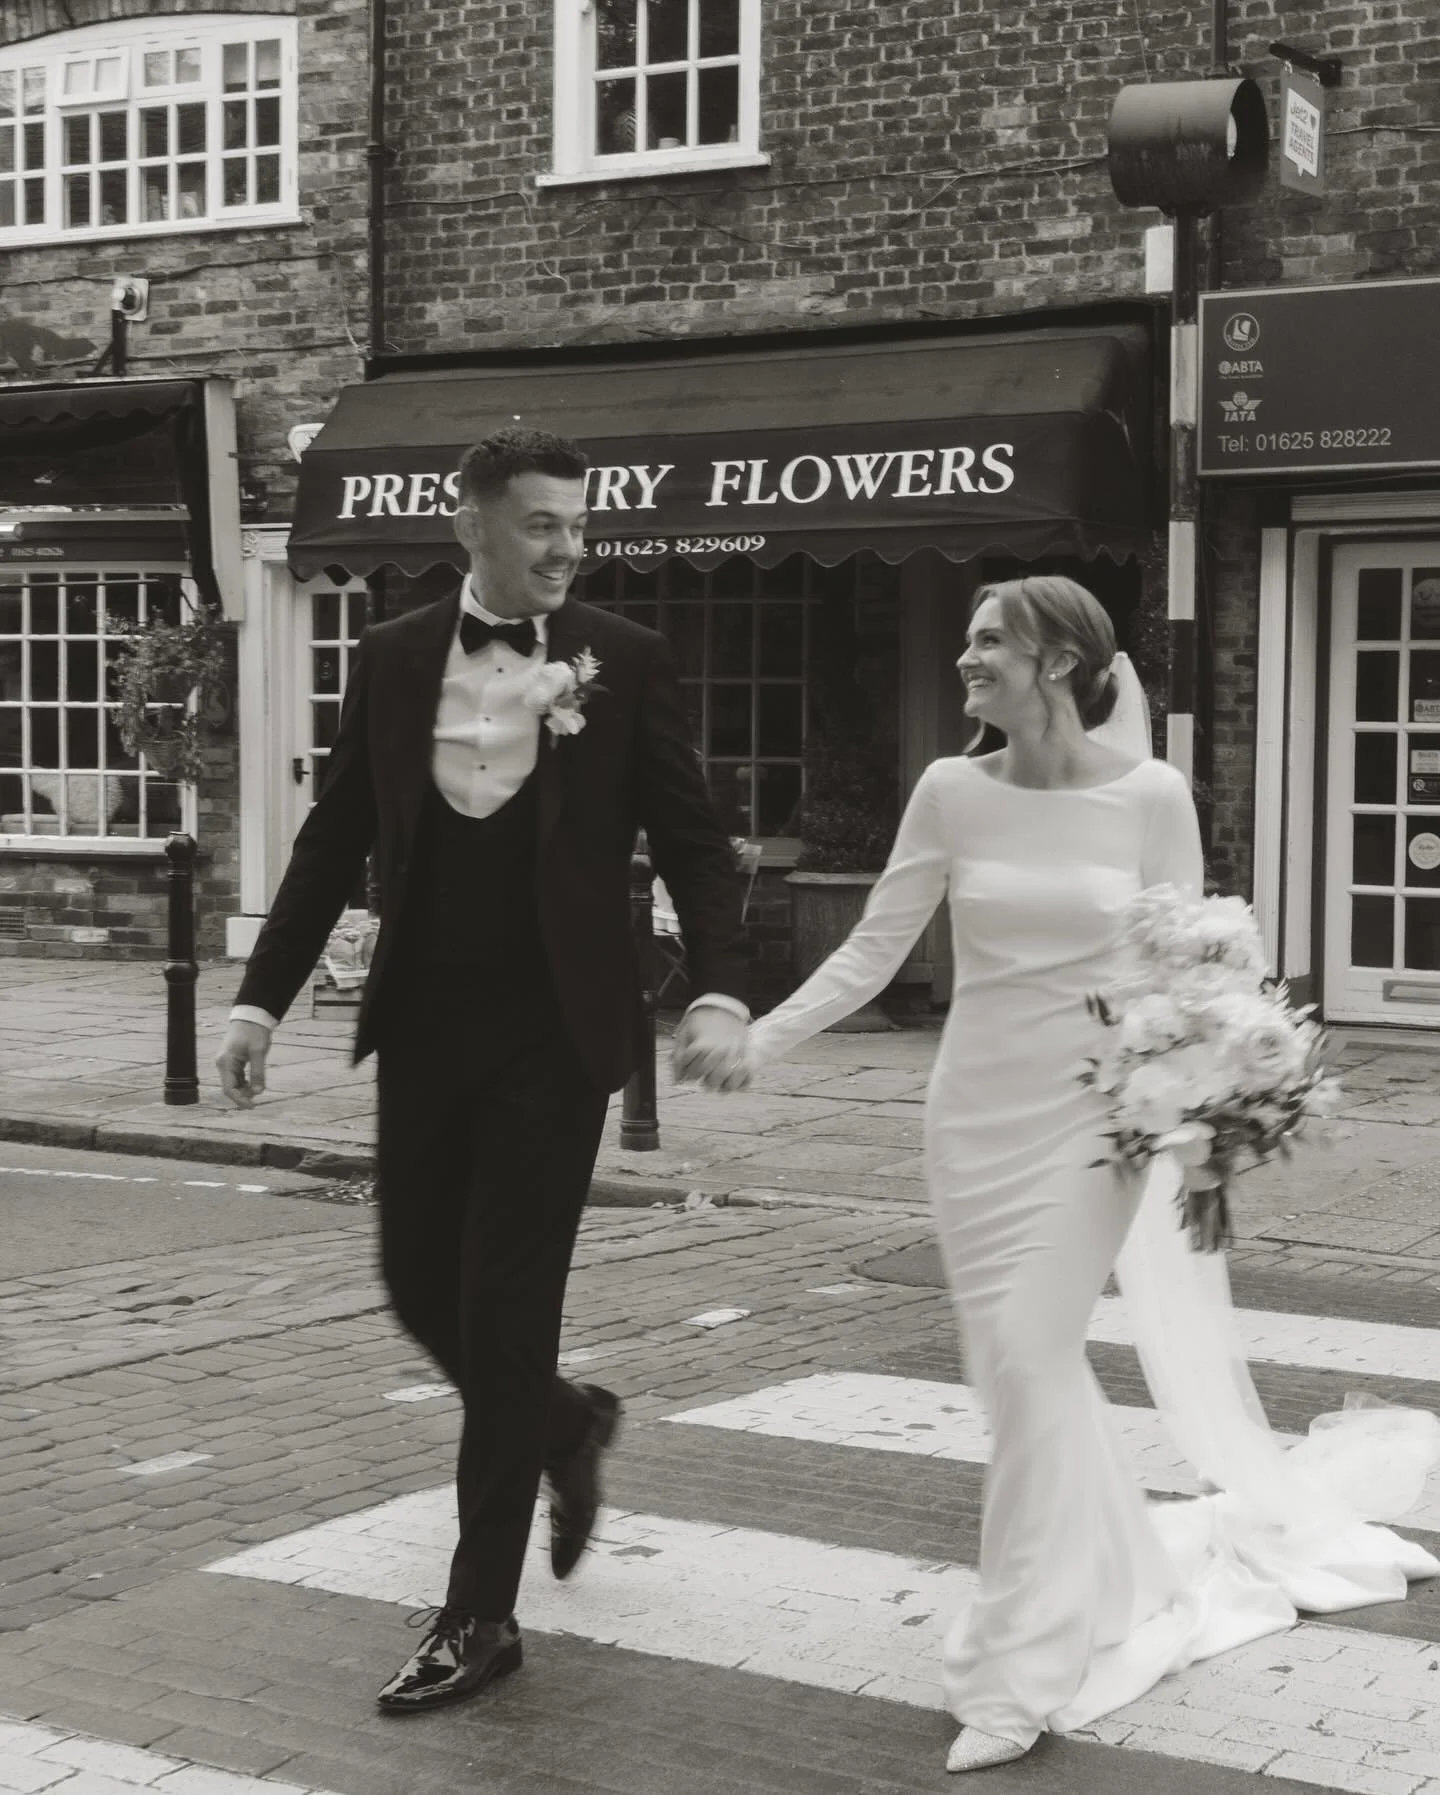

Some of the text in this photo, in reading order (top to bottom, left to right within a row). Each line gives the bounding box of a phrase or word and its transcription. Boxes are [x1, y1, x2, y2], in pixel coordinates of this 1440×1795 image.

[1290, 121, 1314, 149] TRAVEL
[1231, 361, 1264, 373] ABTA
[1224, 410, 1256, 422] IATA
[1217, 428, 1392, 452] Tel: 01625 828222
[336, 443, 1015, 519] PRESRY FLOWERS
[595, 538, 668, 557] 01625
[674, 535, 766, 554] 829609
